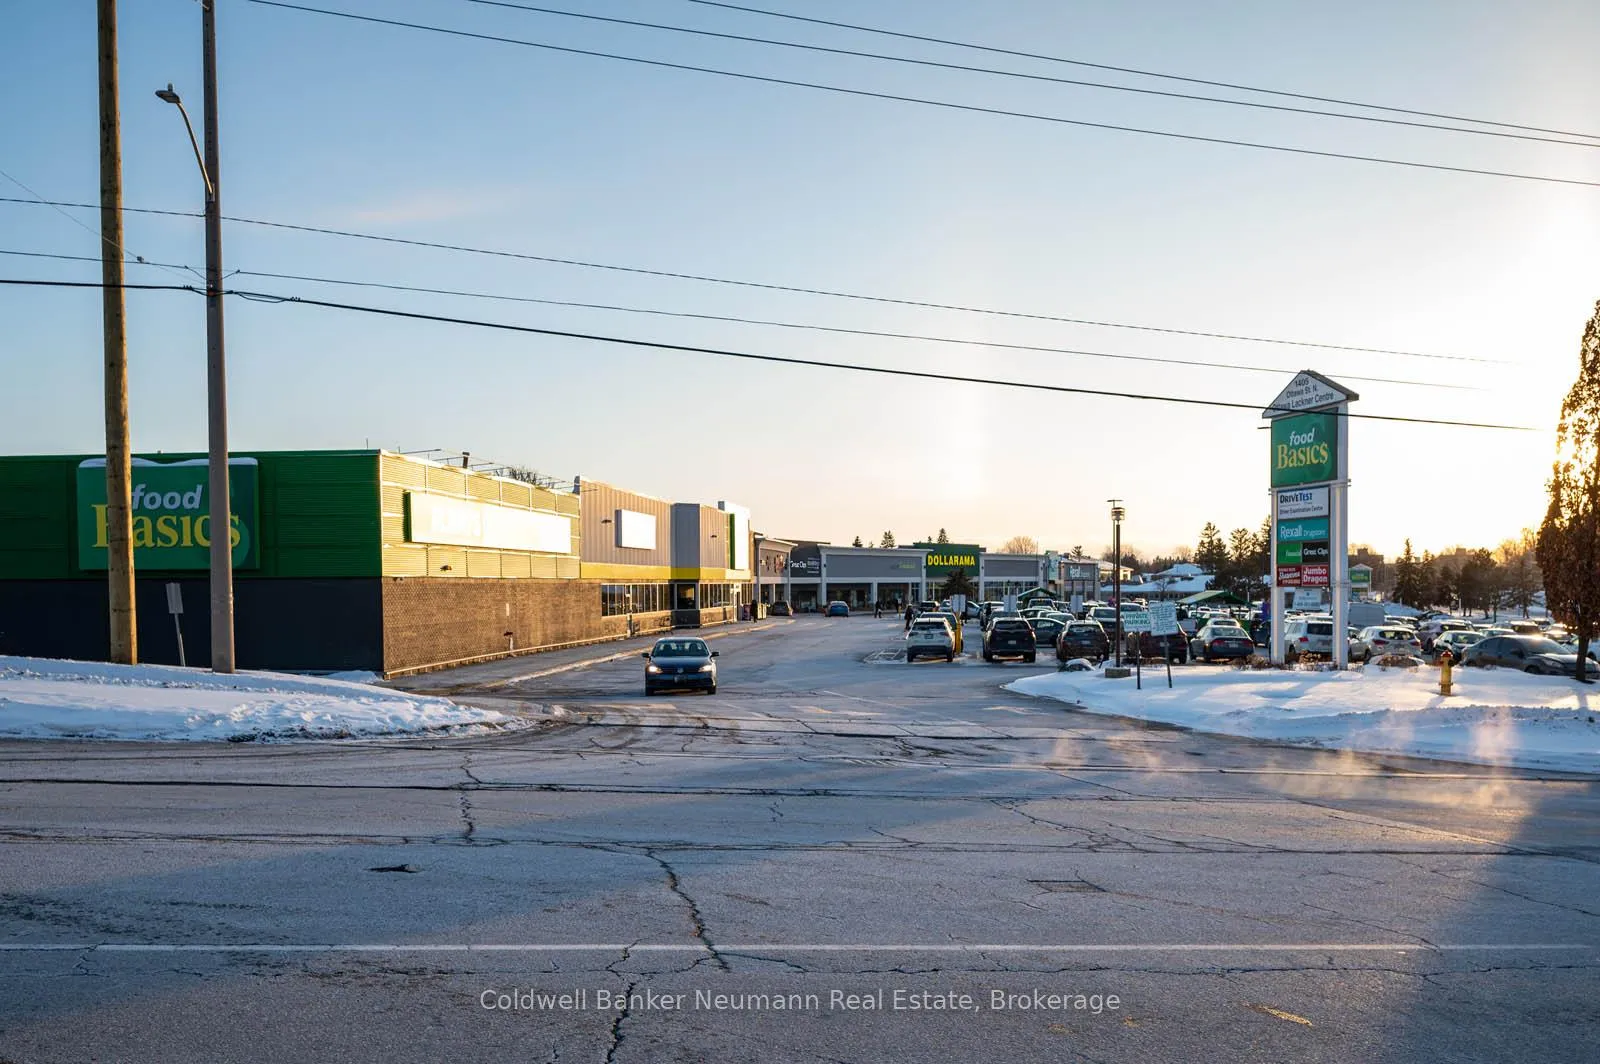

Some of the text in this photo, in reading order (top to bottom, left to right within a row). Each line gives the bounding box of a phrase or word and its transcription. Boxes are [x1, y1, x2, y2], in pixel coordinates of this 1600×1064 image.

[1291, 396, 1314, 408] Lackner
[1314, 391, 1334, 402] Centre
[1289, 427, 1315, 446] food
[131, 484, 203, 510] food
[1280, 524, 1303, 538] Rexall
[927, 554, 976, 566] DOLLARAMA
[1303, 567, 1327, 575] Jumbo
[1303, 575, 1328, 583] Dragon
